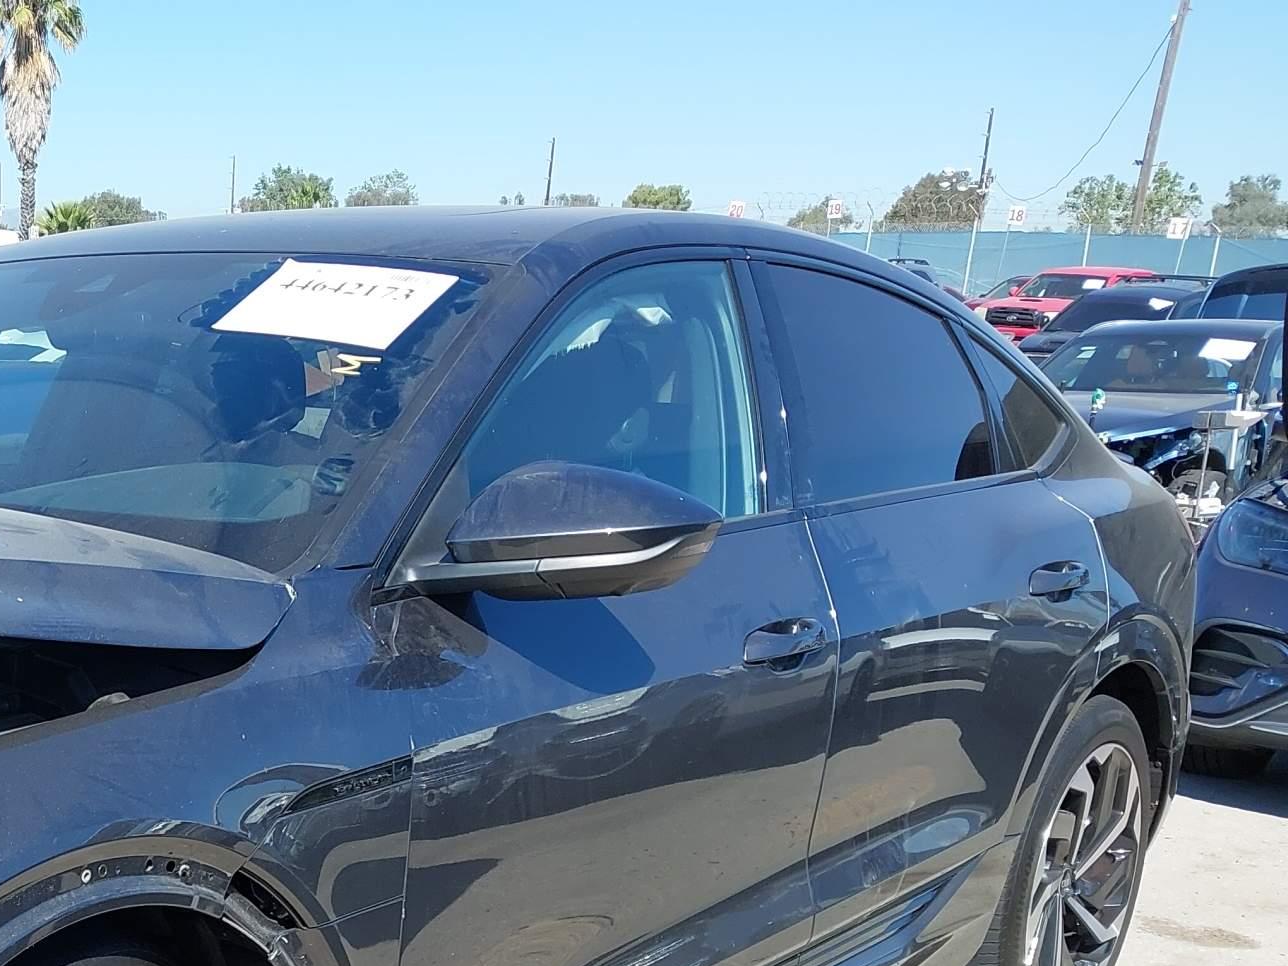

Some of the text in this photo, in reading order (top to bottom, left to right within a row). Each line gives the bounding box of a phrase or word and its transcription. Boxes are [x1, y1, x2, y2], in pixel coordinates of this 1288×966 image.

[729, 204, 744, 218] 20
[828, 203, 842, 216] 19
[1009, 209, 1025, 222] 18
